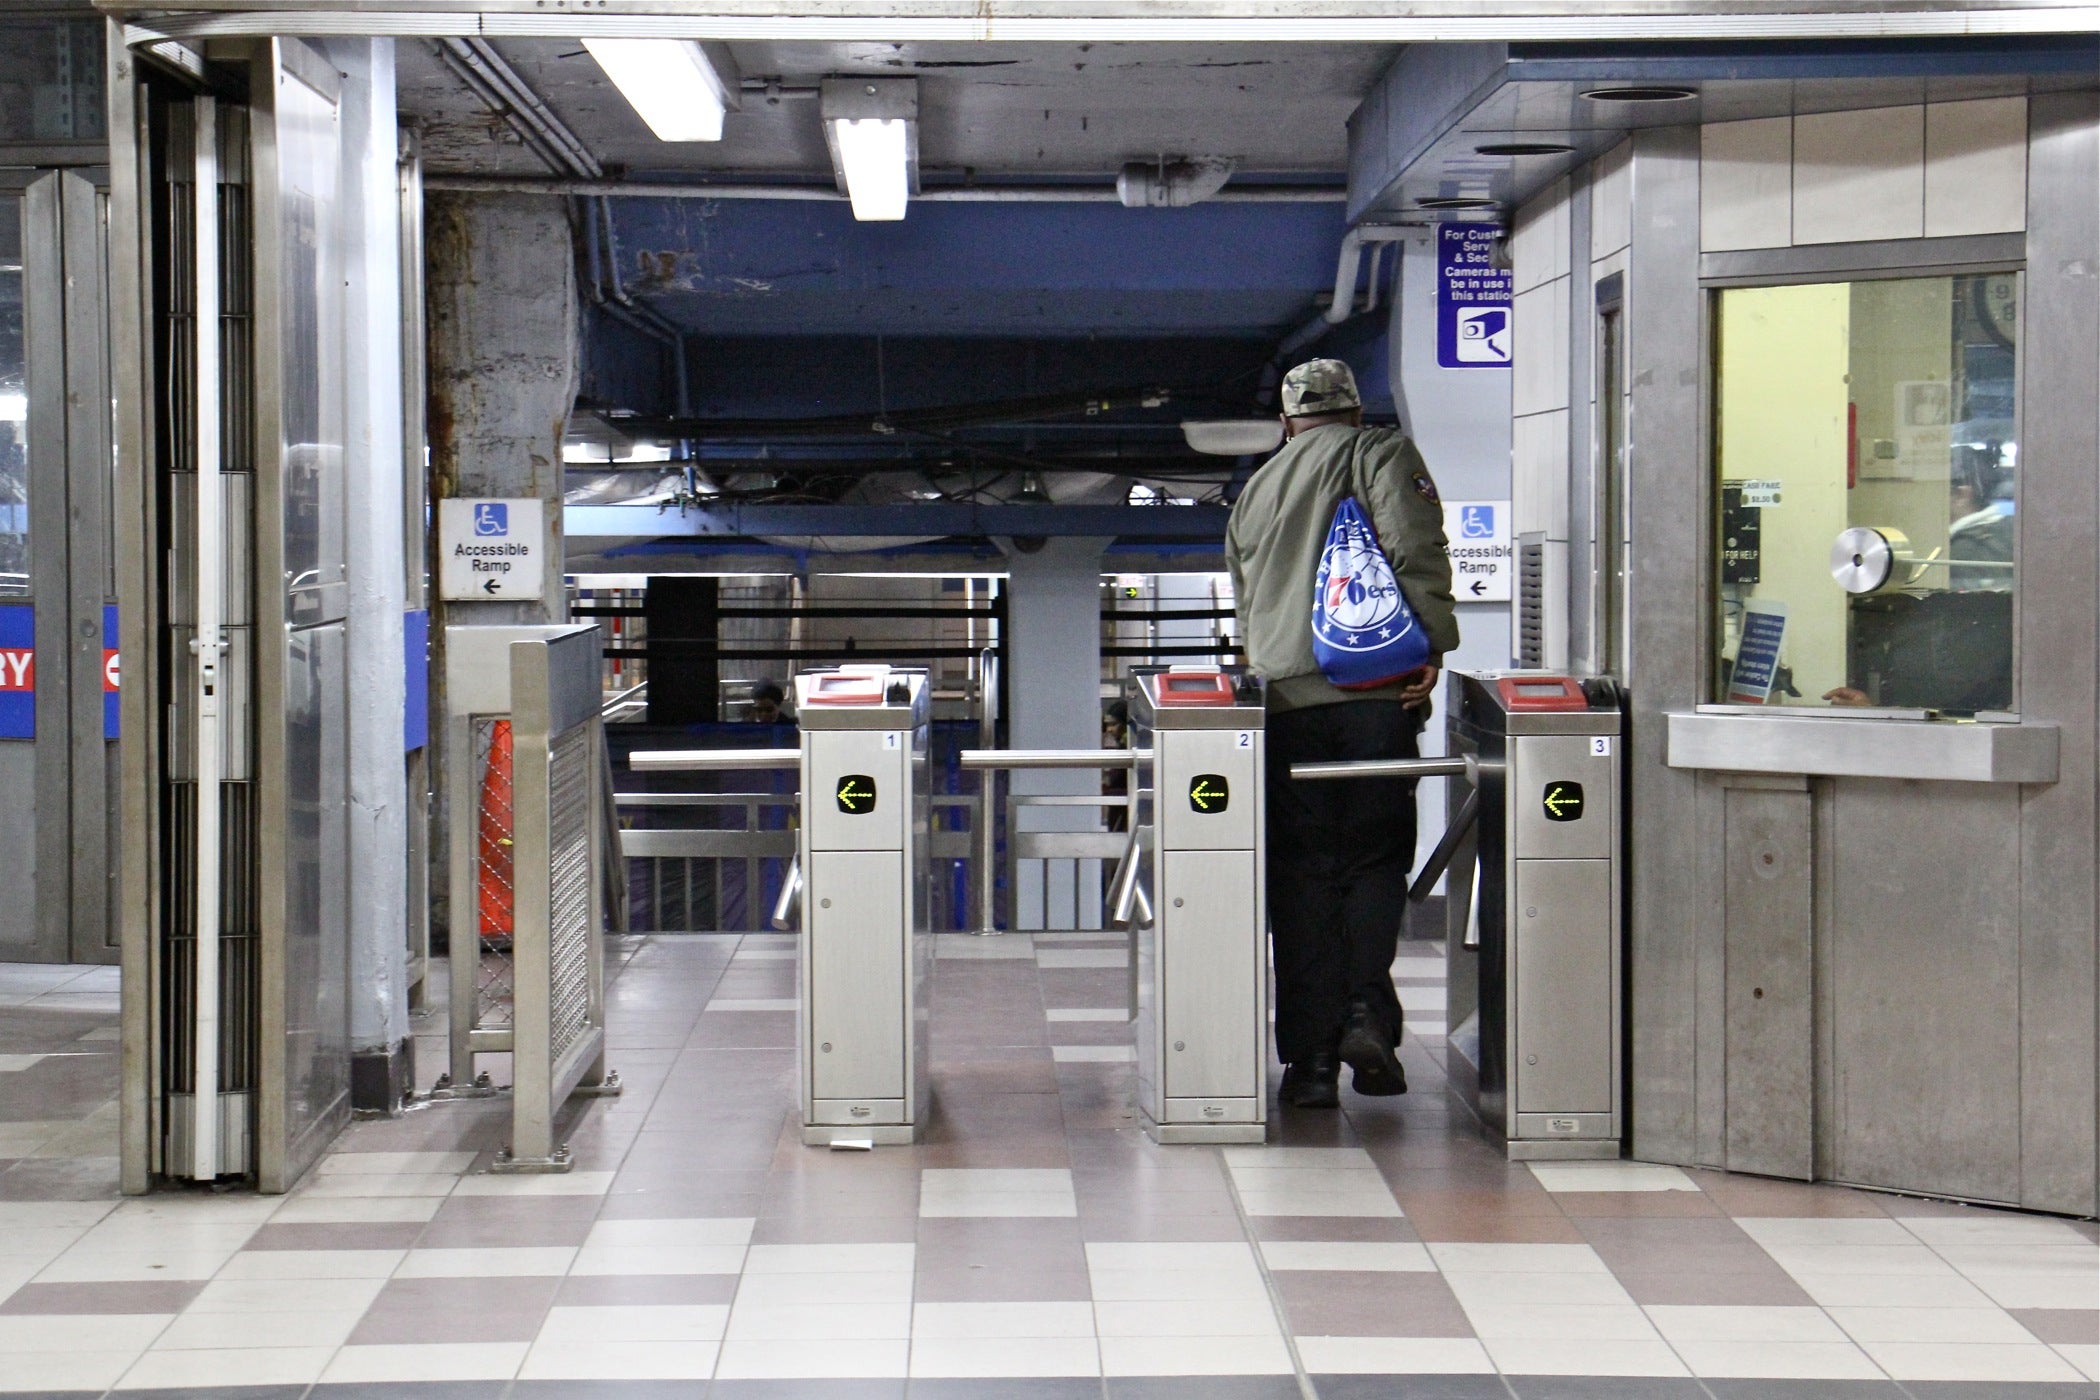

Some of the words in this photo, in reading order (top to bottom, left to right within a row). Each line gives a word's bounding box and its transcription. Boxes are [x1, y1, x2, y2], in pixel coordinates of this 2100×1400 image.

[1445, 230, 1465, 240] For
[1468, 230, 1497, 240] Cust
[1463, 241, 1490, 251] Serv
[1454, 253, 1463, 263] &
[1466, 253, 1489, 263] Sec
[1445, 266, 1497, 277] Cameras
[1500, 268, 1513, 277] m
[1450, 279, 1465, 289] be
[1468, 279, 1480, 289] in
[1483, 280, 1505, 289] use
[1507, 279, 1511, 289] i
[1451, 290, 1474, 301] this
[1477, 290, 1513, 301] statio
[455, 543, 528, 556] Accessible
[472, 559, 511, 575] Ramp
[1459, 561, 1497, 576] Ramp
[888, 734, 895, 747] 1
[1240, 733, 1249, 747] 2
[1595, 739, 1605, 753] 3
